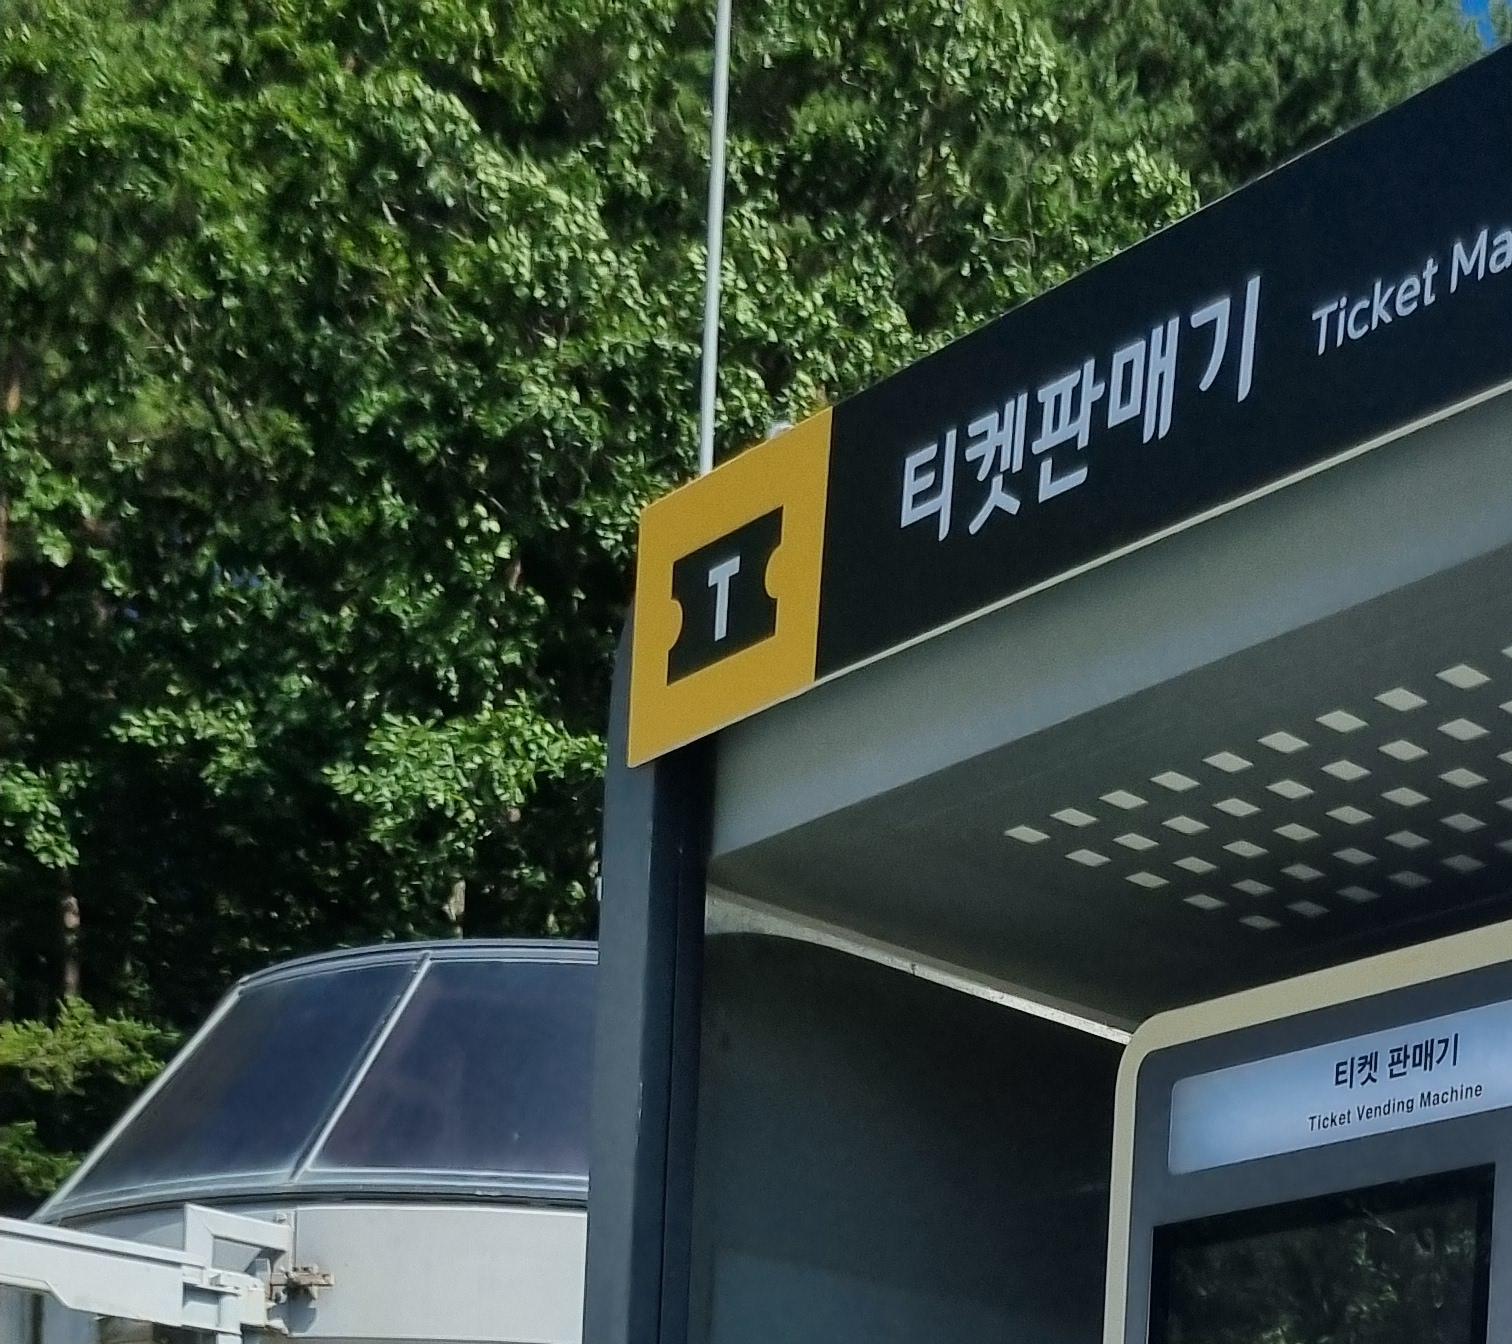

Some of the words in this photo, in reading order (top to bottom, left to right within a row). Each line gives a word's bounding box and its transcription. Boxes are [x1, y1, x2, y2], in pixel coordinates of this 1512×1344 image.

[1310, 257, 1436, 358] Ticket
[898, 275, 1262, 541] 티켓판매기
[706, 553, 742, 643] T
[1334, 1050, 1379, 1090] 티켓
[1388, 1032, 1459, 1080] 판매기
[1308, 1109, 1352, 1132] Ticket
[1356, 1097, 1415, 1122] Vending
[1419, 1082, 1483, 1109] Machine
